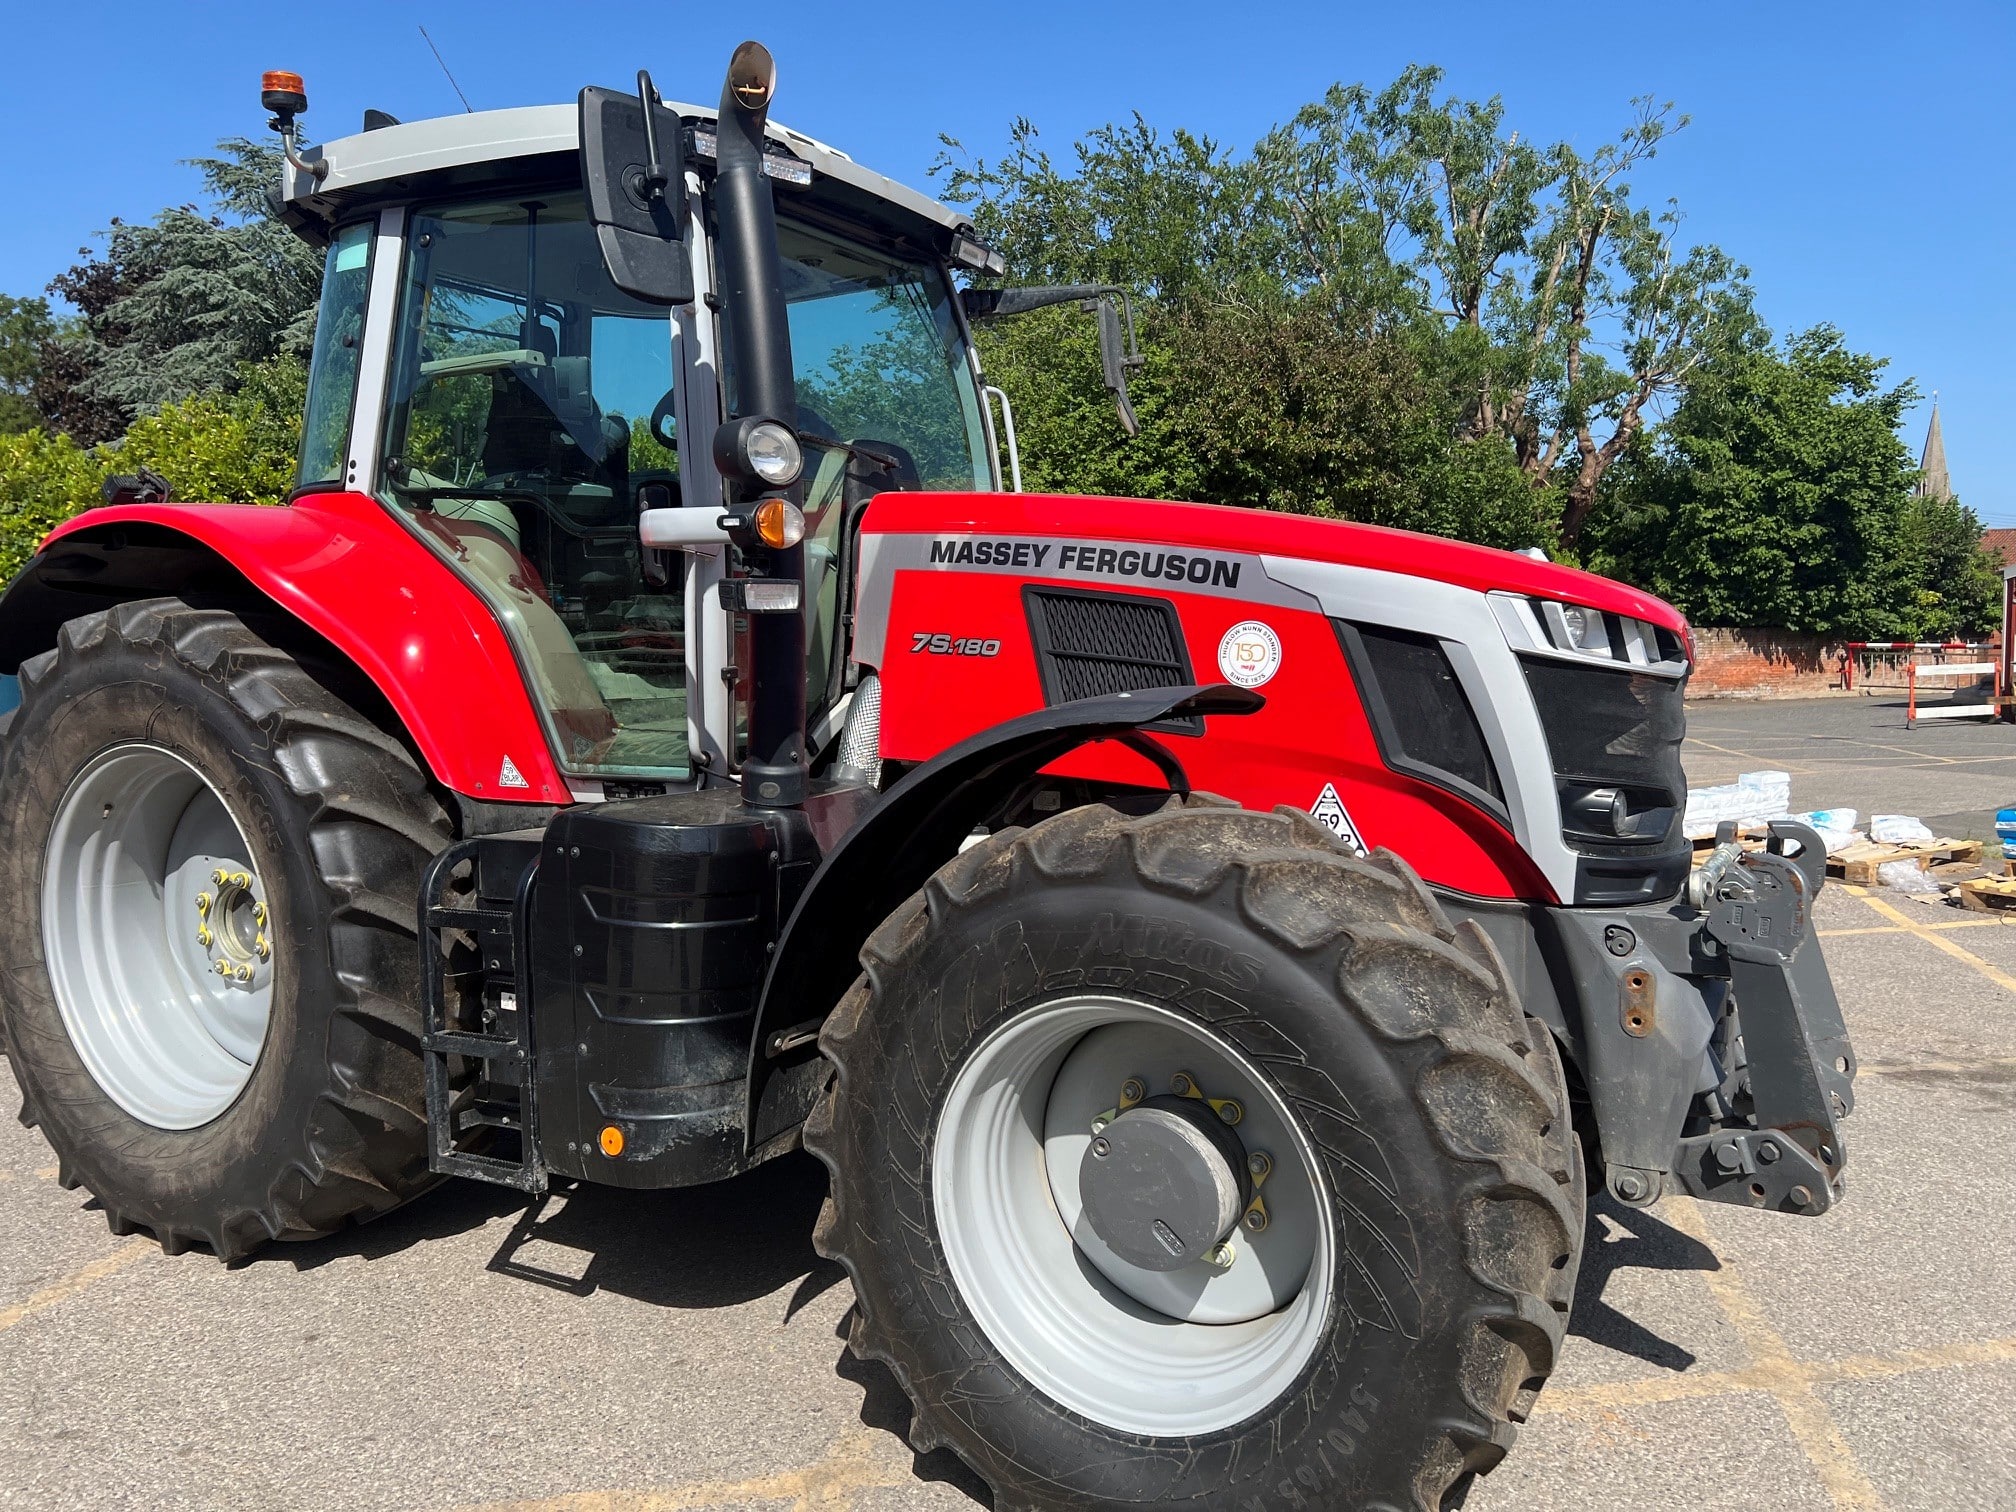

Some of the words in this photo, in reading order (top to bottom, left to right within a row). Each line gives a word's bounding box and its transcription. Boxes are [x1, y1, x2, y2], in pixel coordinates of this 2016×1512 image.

[930, 540, 1051, 568] MASSEY
[1059, 545, 1241, 588] FERGUSON
[911, 633, 1000, 657] 7S.180
[1222, 628, 1240, 659] THURLOW
[1263, 631, 1277, 662] STANDEN
[1234, 642, 1266, 662] 150
[1230, 672, 1249, 683] SINCE
[1318, 813, 1340, 830] 59
